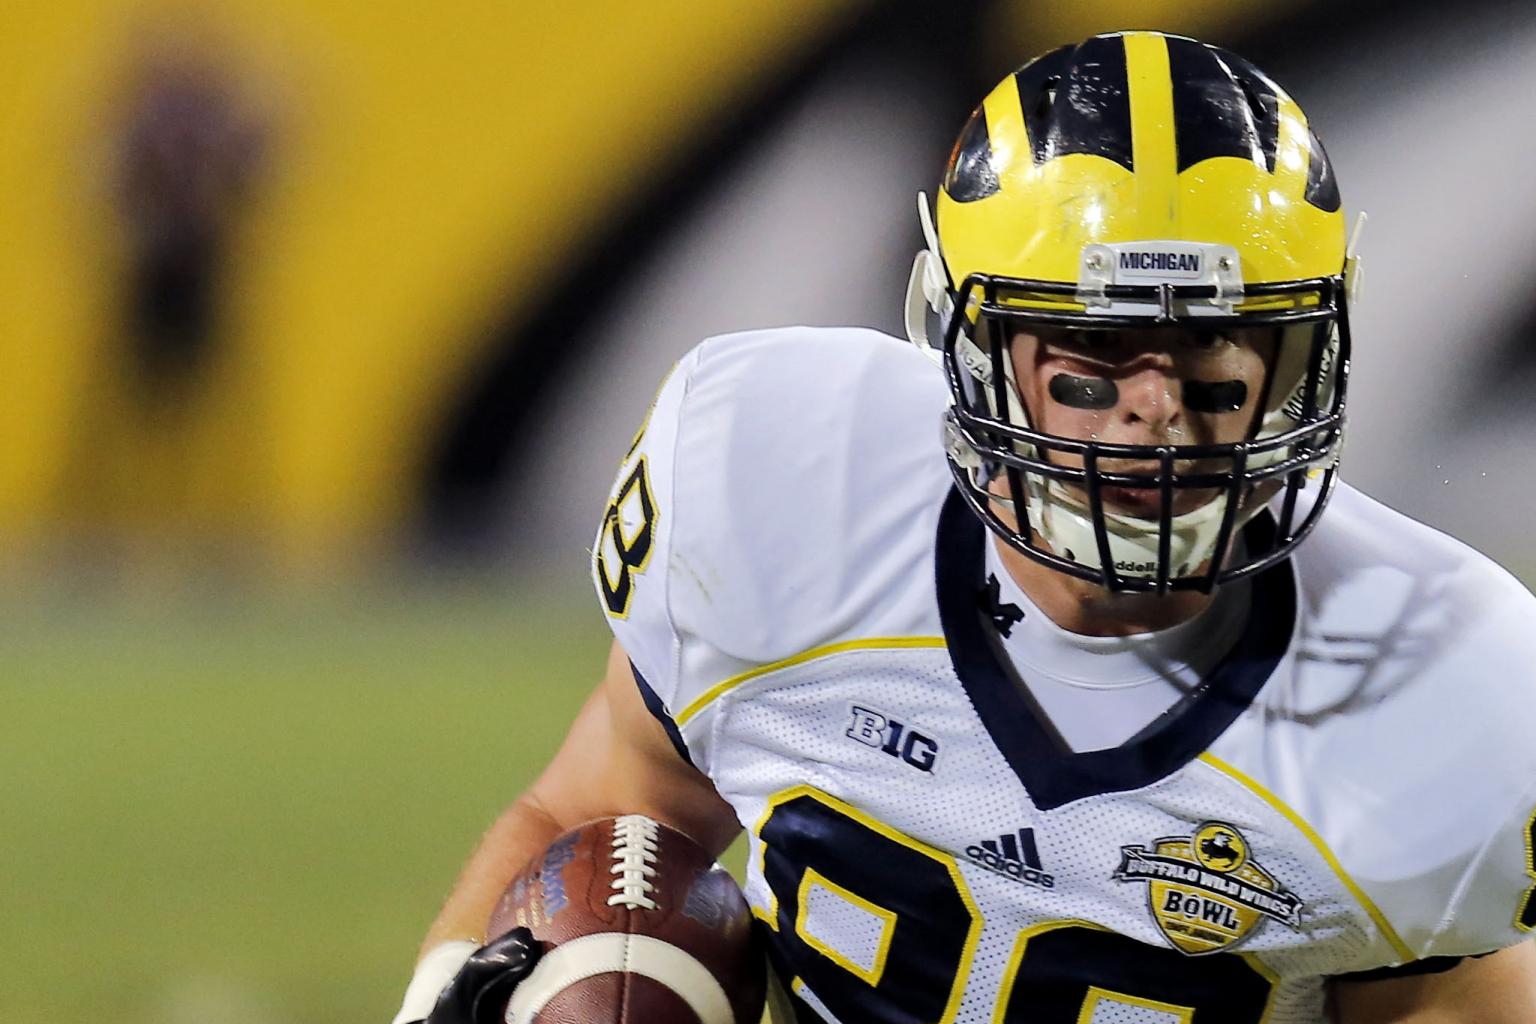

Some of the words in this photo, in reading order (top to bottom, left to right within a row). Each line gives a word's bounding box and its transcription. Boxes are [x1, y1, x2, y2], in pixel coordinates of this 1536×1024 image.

[1120, 252, 1199, 271] MICHIGAN
[1115, 560, 1156, 572] ddell
[965, 844, 1054, 888] adidas
[1126, 858, 1200, 883] BUFFALO
[1200, 871, 1241, 896] WILD
[1239, 885, 1293, 917] WINGS
[1163, 889, 1240, 931] BOWL
